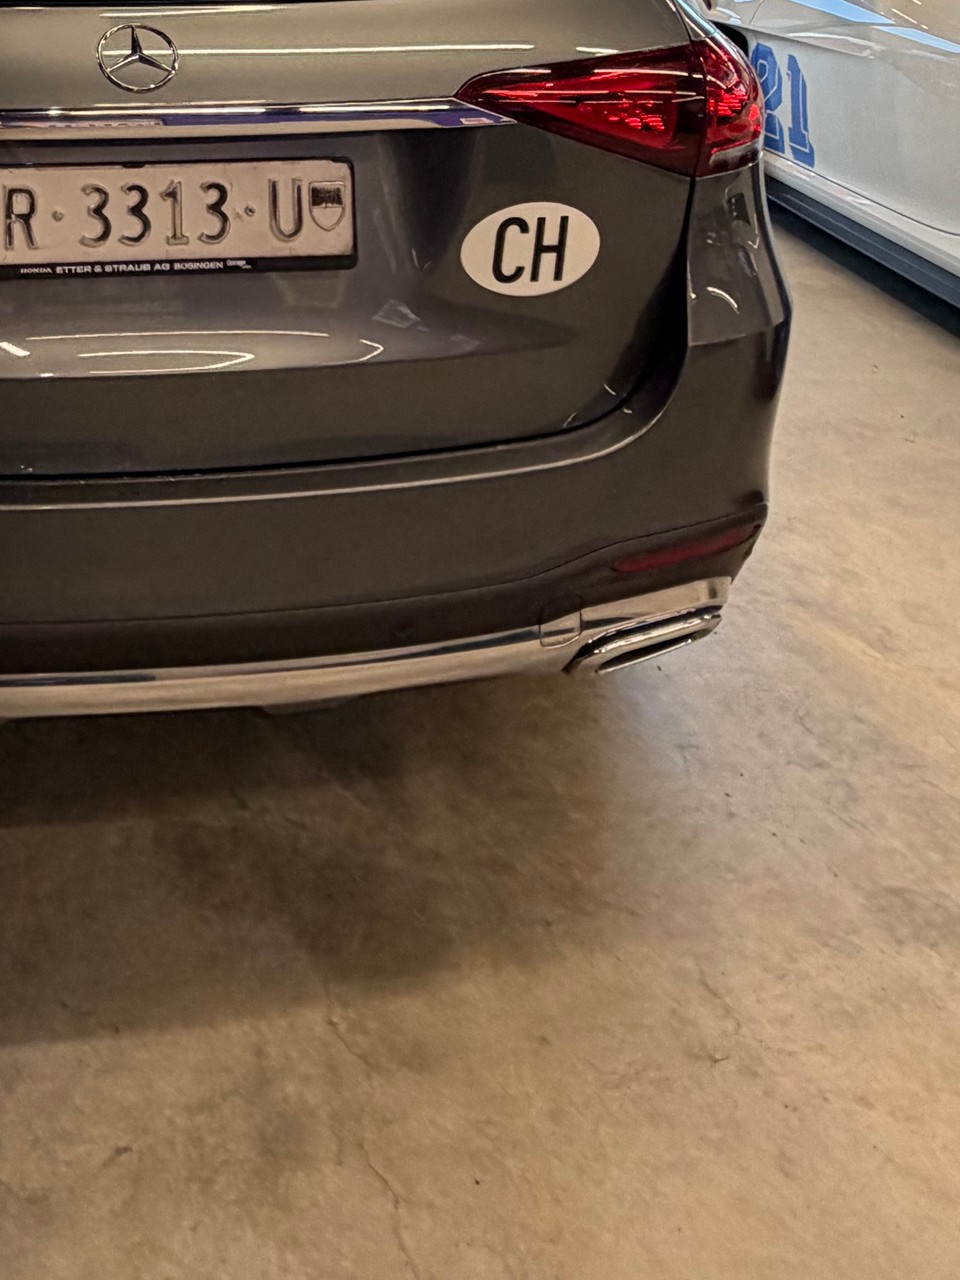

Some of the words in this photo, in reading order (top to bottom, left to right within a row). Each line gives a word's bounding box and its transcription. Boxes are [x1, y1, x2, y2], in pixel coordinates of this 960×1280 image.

[751, 42, 815, 169] 21
[81, 179, 232, 247] 3313
[268, 177, 304, 242] U
[56, 265, 92, 275] ETTER
[104, 263, 151, 273] STRAUB
[153, 262, 170, 271] AG
[492, 215, 569, 284] CH
